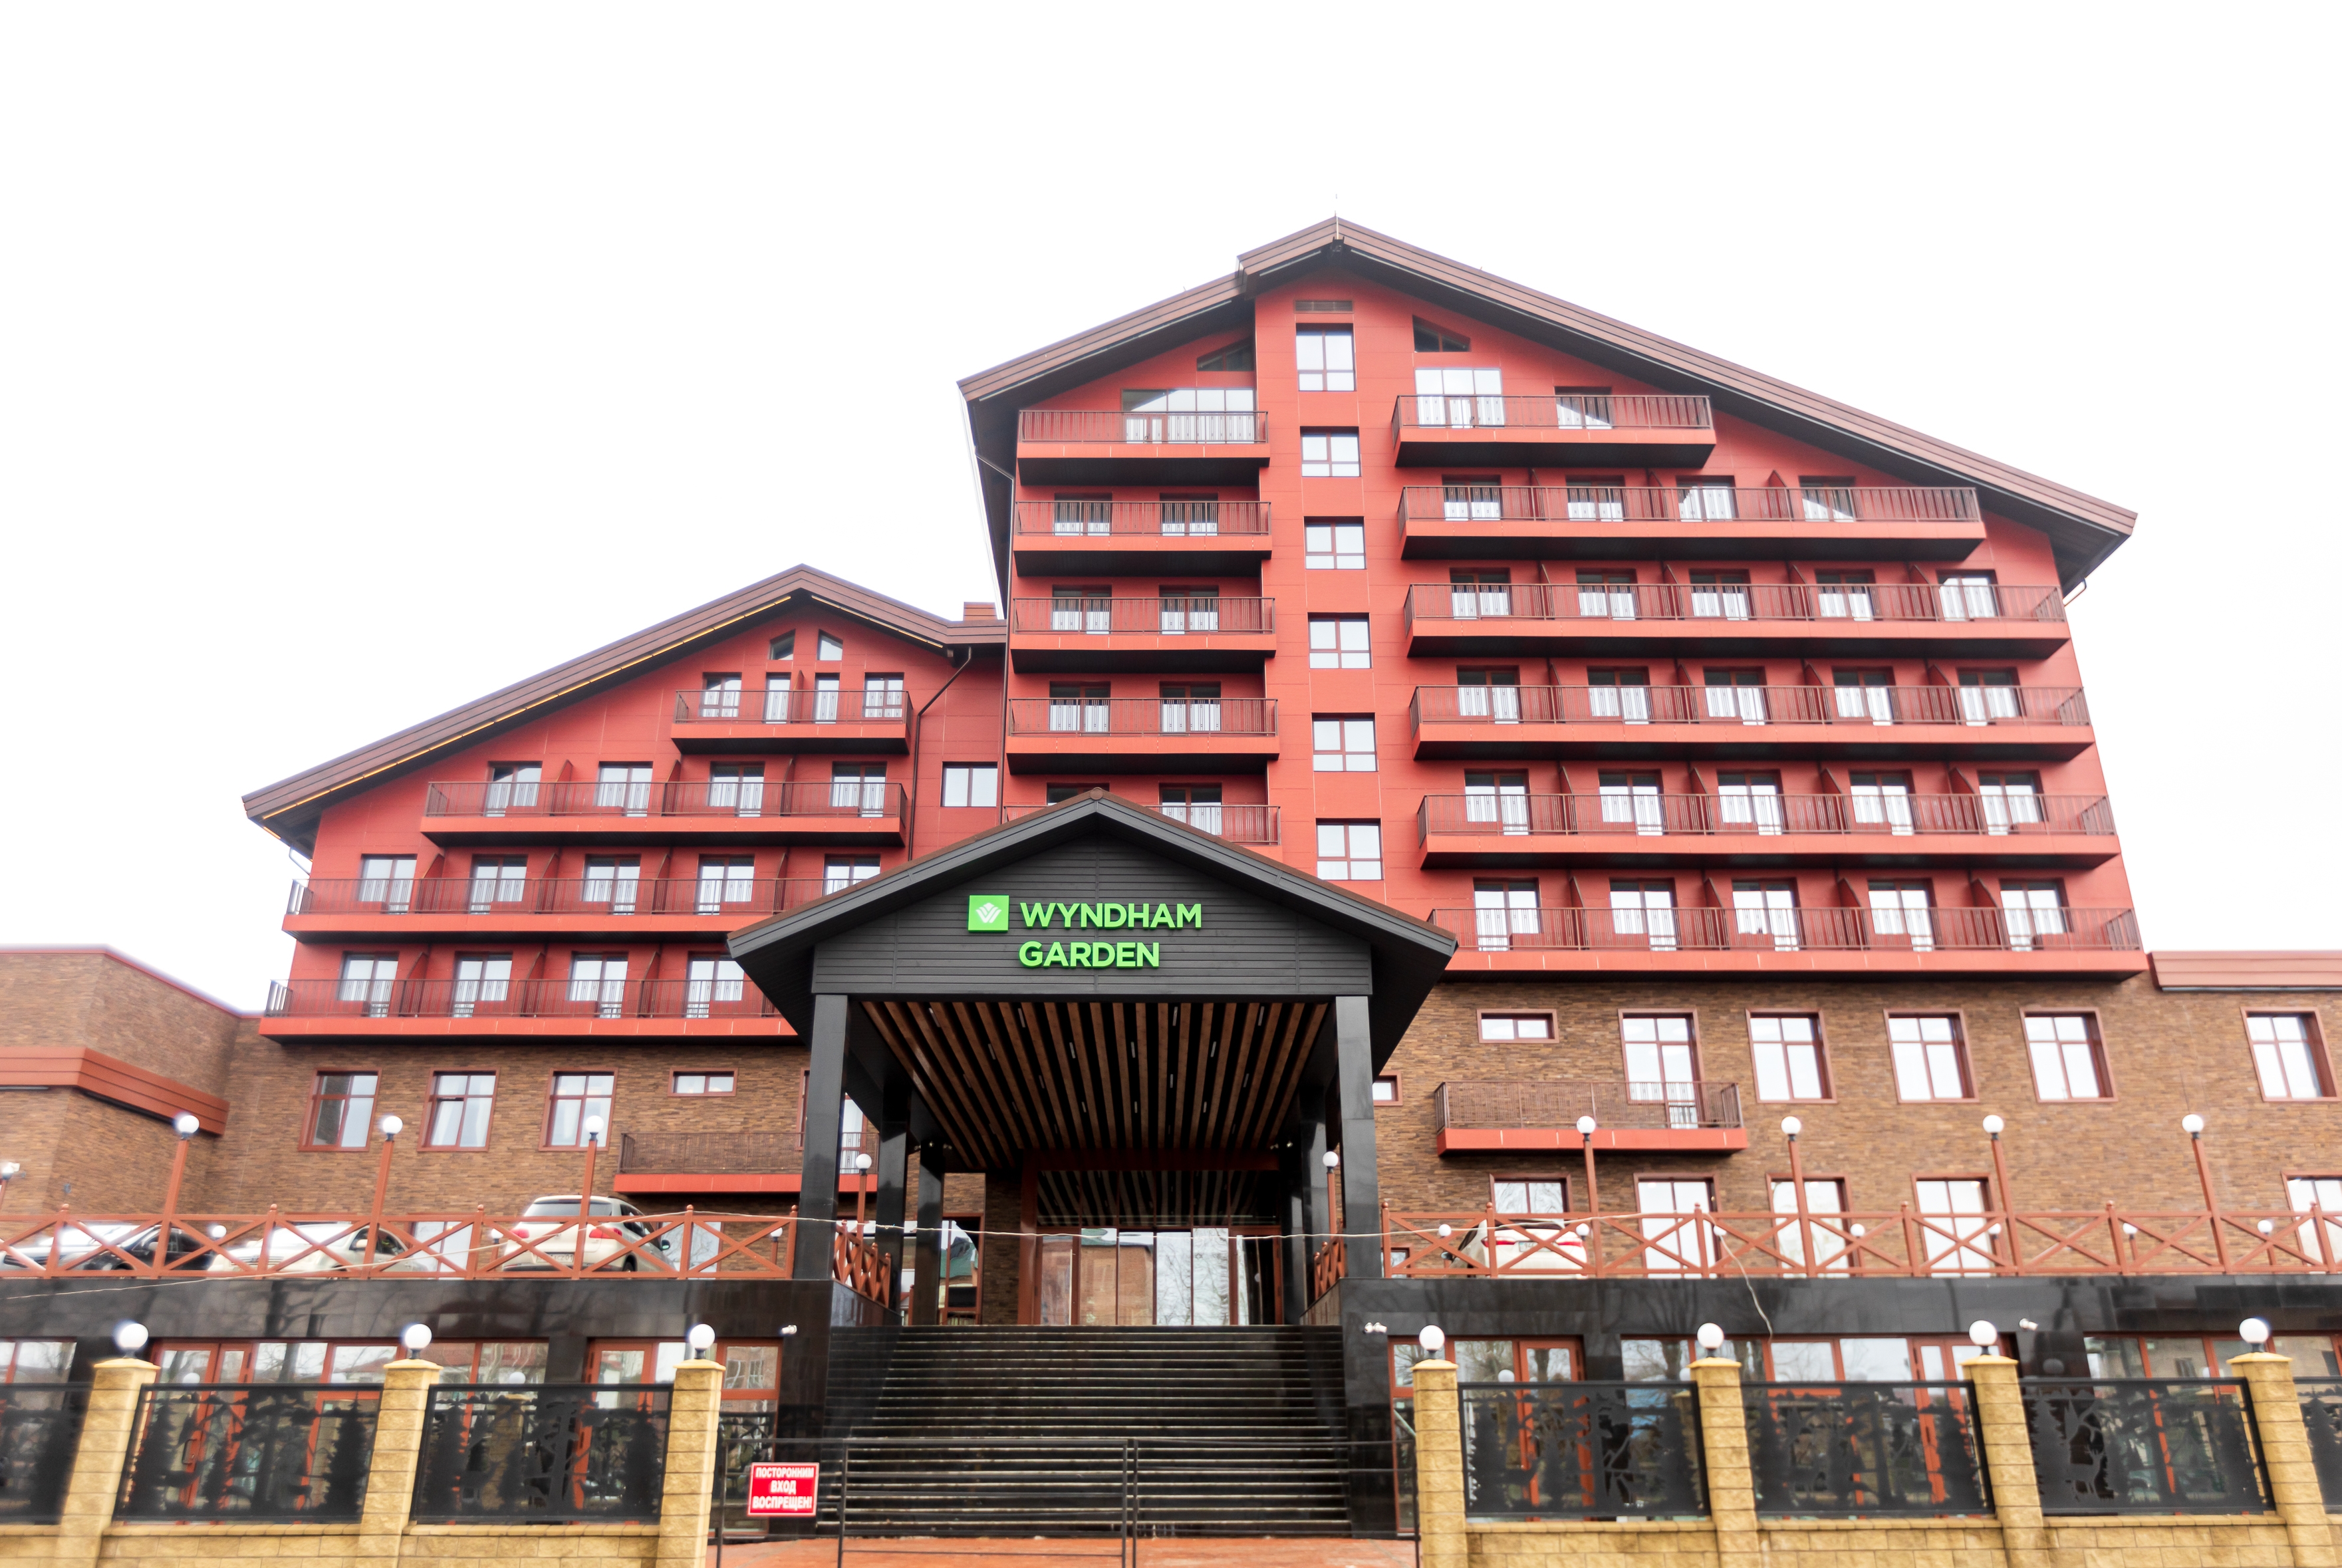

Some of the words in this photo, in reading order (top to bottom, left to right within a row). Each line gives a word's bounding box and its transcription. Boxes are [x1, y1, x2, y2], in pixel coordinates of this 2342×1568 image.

[1020, 902, 1202, 929] WYNDHAM
[1019, 941, 1160, 968] GARDEN
[755, 1467, 814, 1478] ПОСТОРОННИМ
[771, 1480, 797, 1494] ВХОД
[753, 1497, 813, 1510] ВОСПРЕЩЕН!
